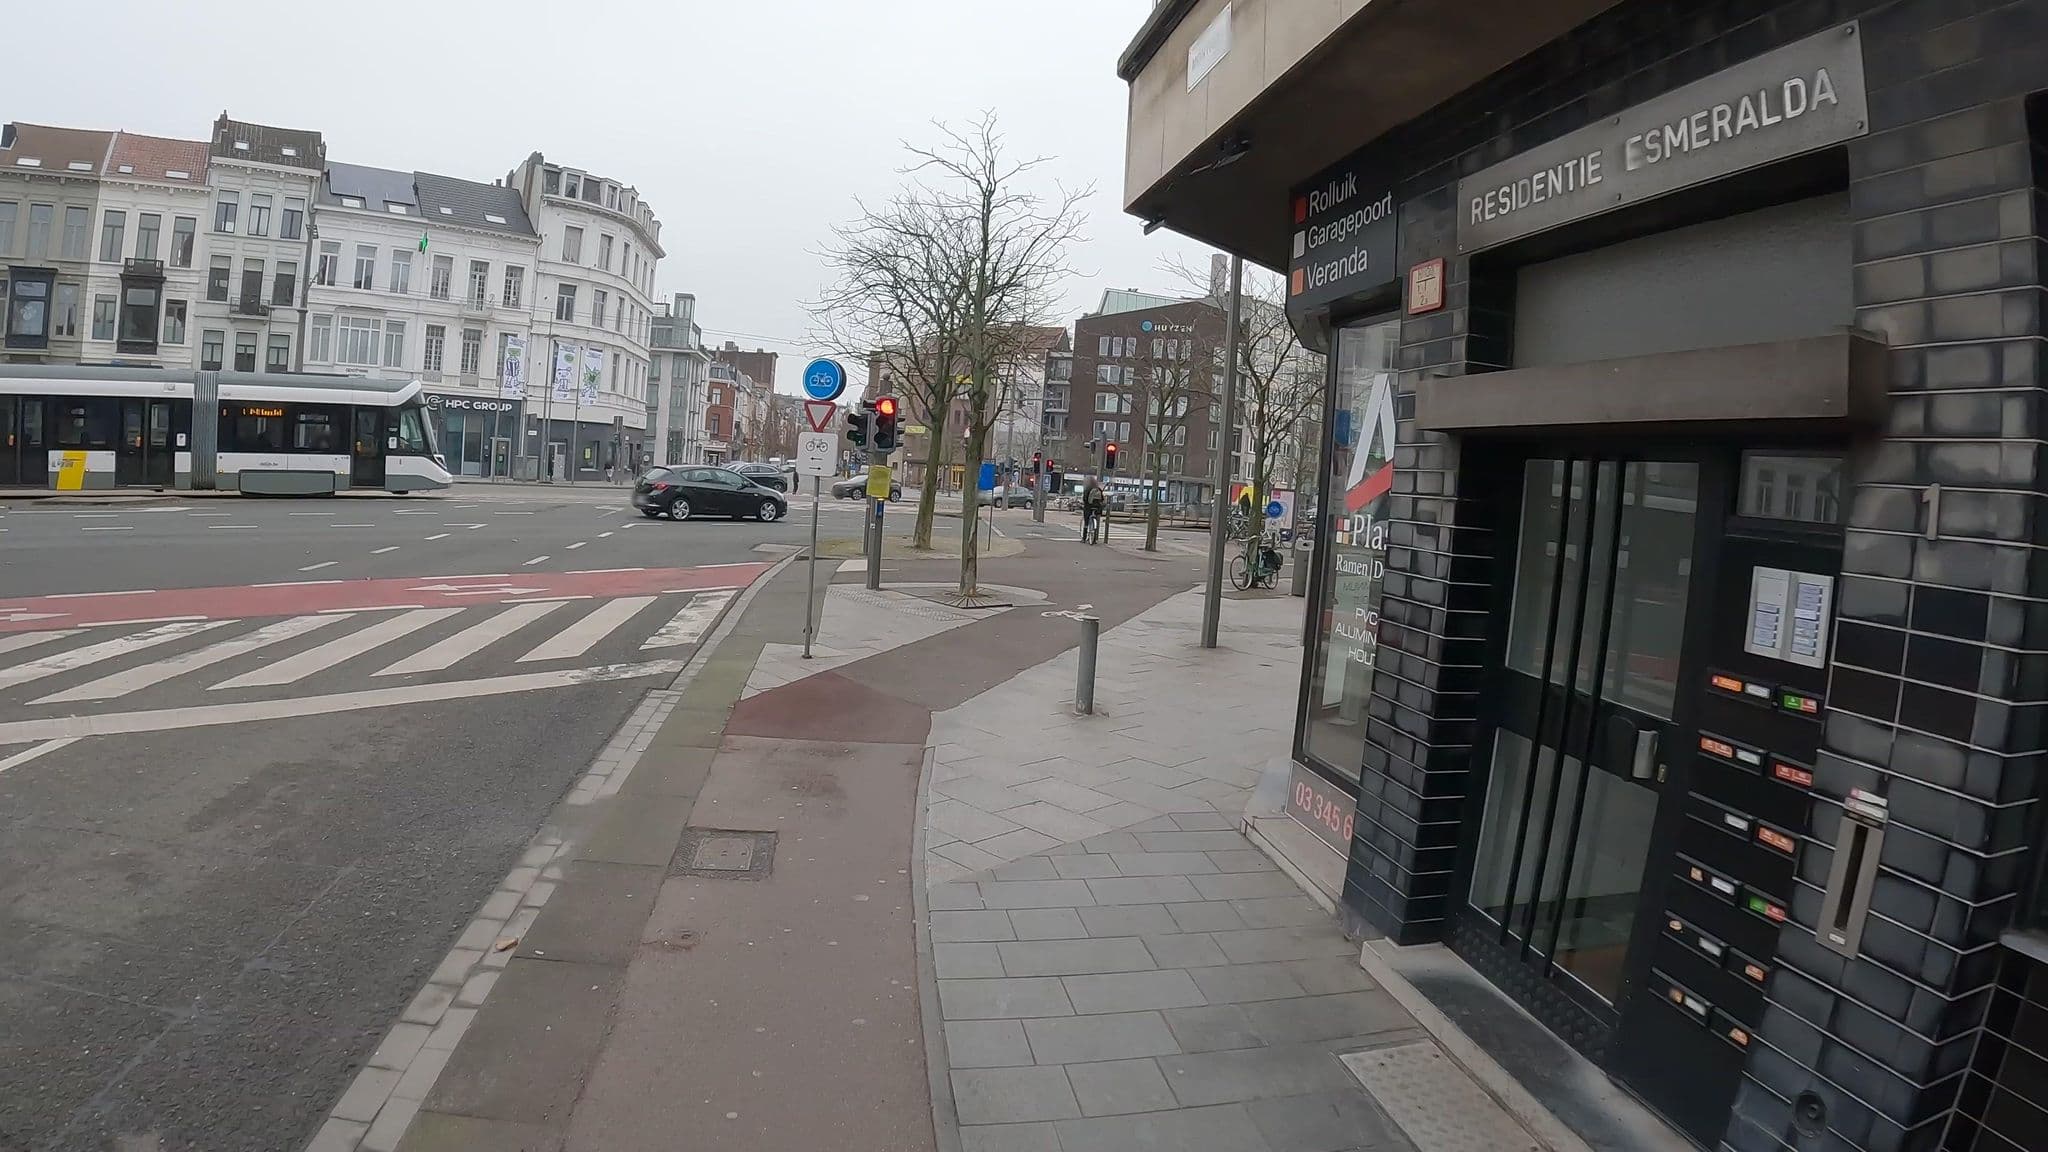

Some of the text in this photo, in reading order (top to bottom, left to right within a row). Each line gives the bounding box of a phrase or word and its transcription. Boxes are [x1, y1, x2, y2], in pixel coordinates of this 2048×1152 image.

[1471, 67, 1839, 226] RESIDENTIE ESMERALDA
[1308, 171, 1358, 217] Rolluik
[1307, 191, 1393, 249] Garagepoort
[1306, 246, 1368, 290] Veranda
[445, 399, 513, 411] HPC GROUP
[1335, 554, 1368, 577] Ramen
[1335, 622, 1377, 646] ALUMIN
[1355, 607, 1378, 626] PVC
[1295, 781, 1312, 812] 03
[1313, 794, 1341, 832] 345
